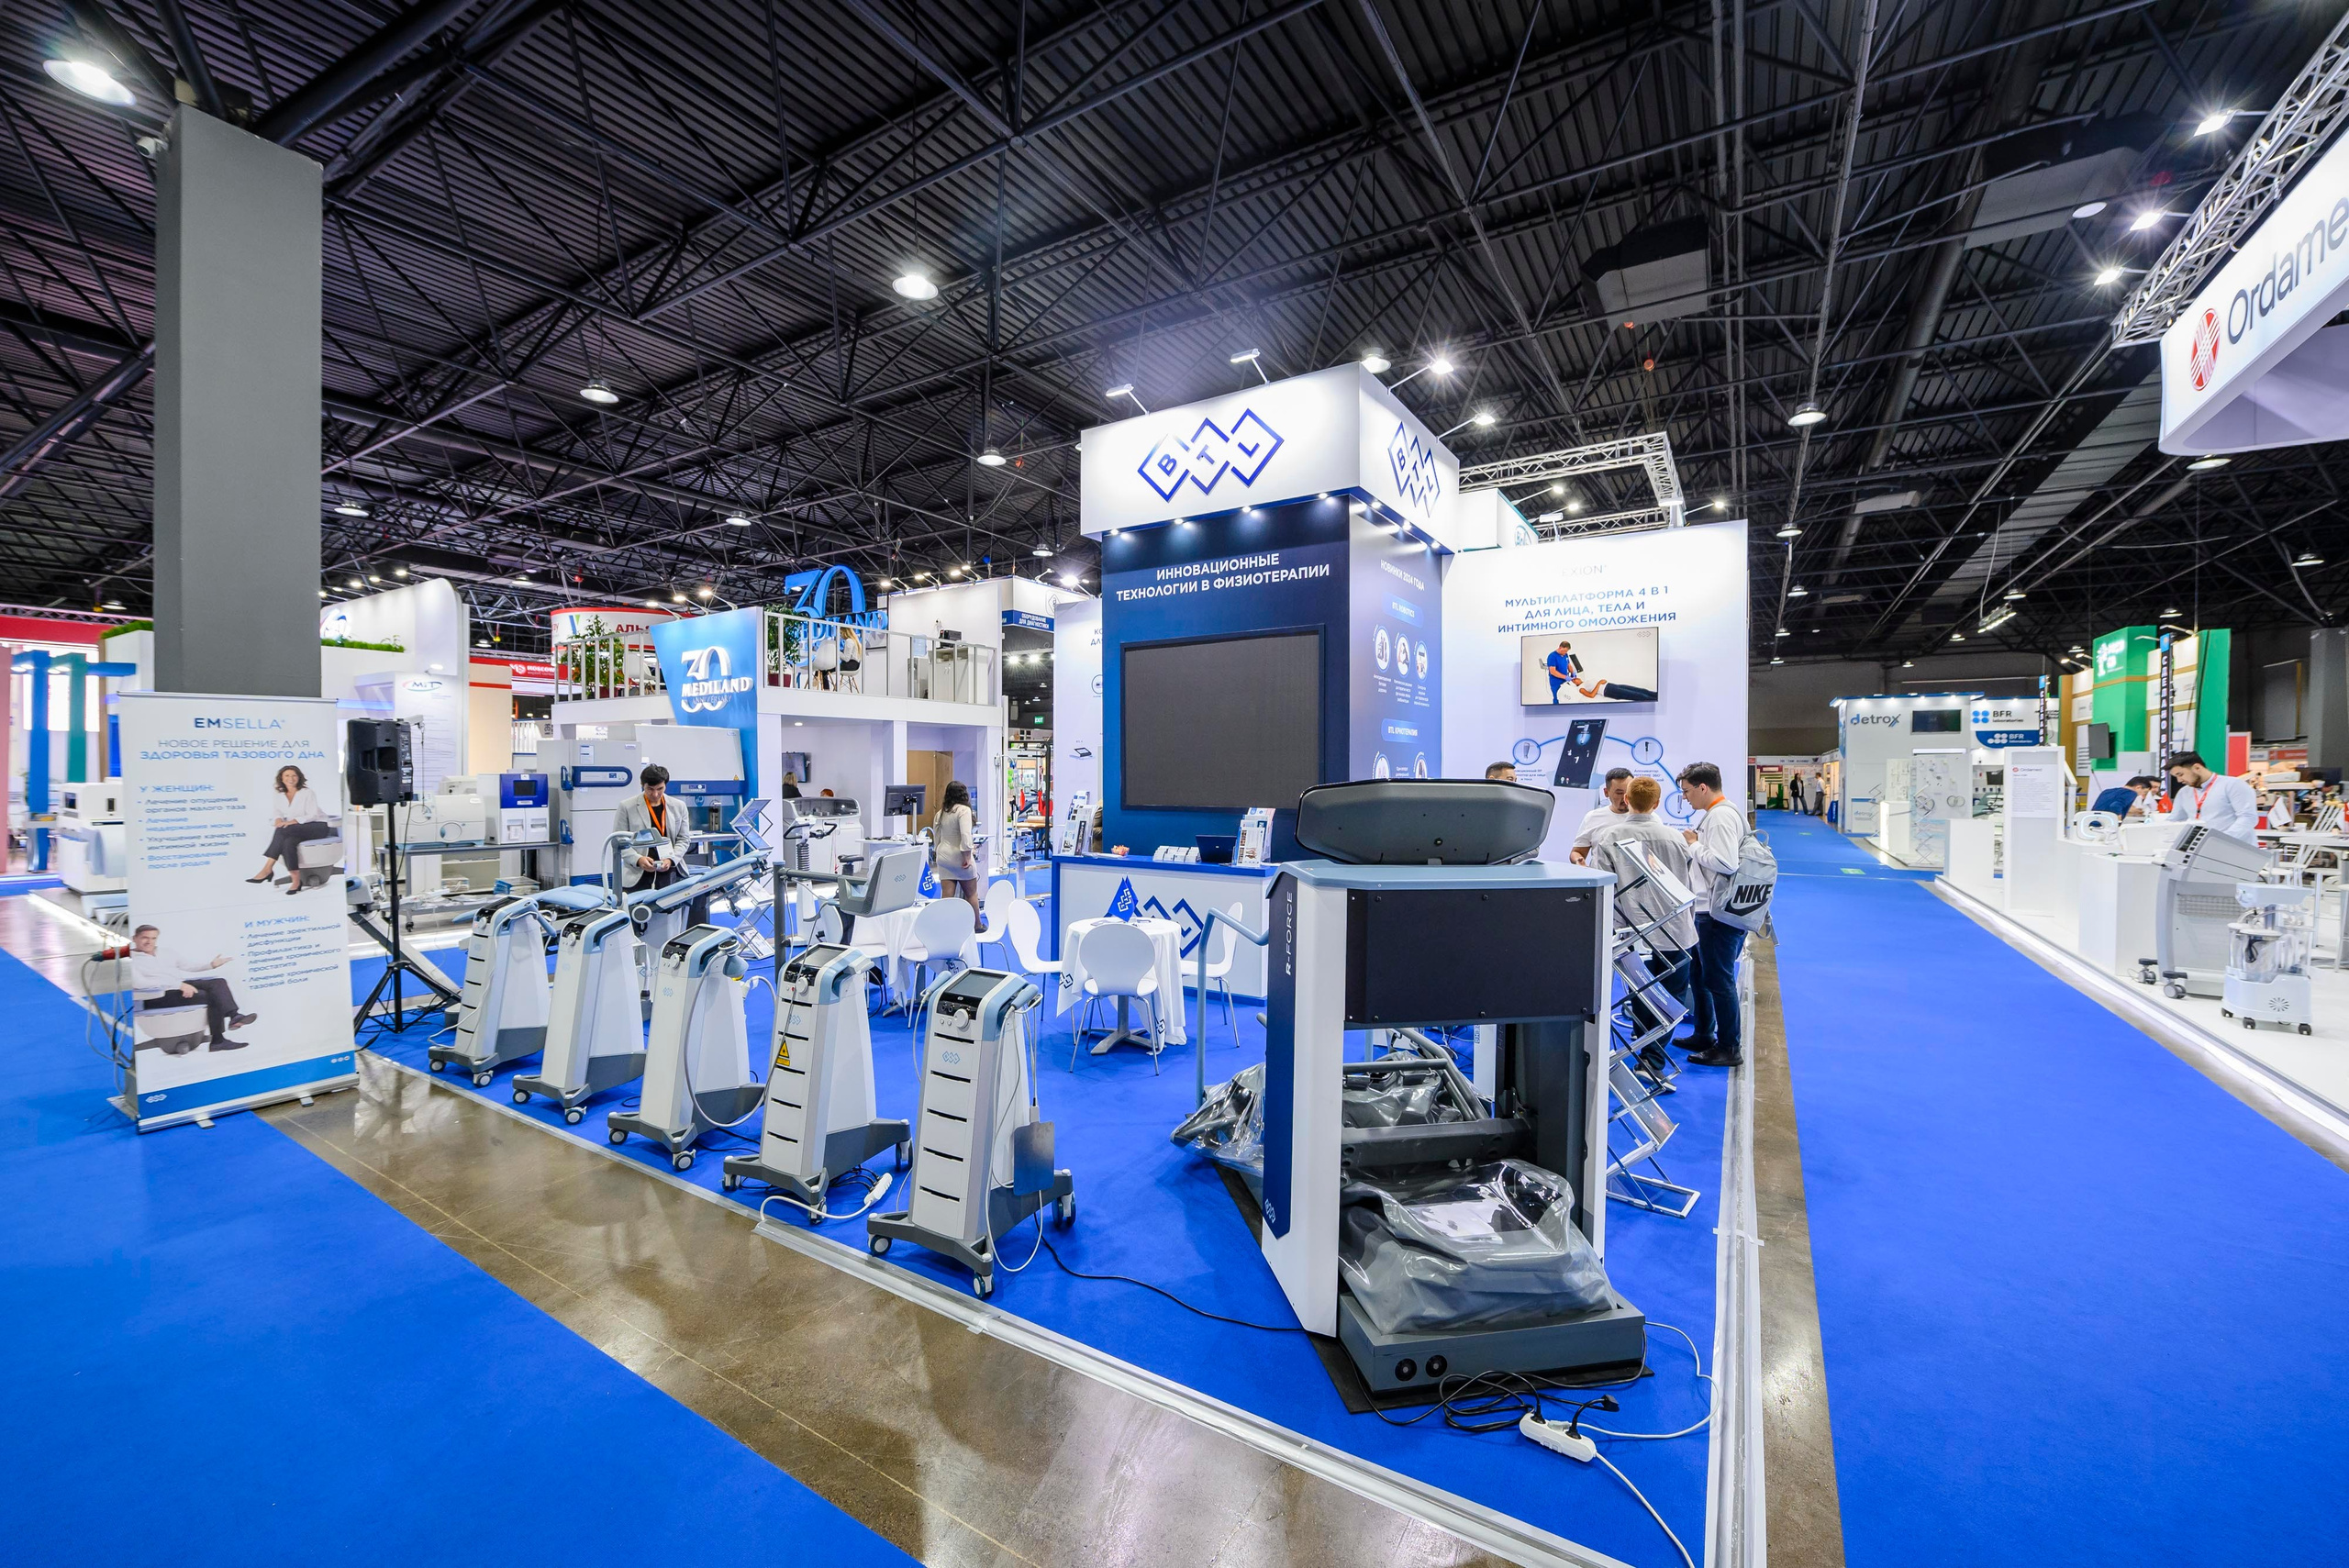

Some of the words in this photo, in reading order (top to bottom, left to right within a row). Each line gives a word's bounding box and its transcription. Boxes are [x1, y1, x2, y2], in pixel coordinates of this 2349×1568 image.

[1156, 553, 1279, 581] ИННОВАЦИОННЫЕ
[1562, 564, 1603, 577] EXION
[1381, 559, 1403, 579] НОВИНКИ
[1403, 572, 1413, 585] 2024
[1413, 577, 1425, 591] ГОДА
[1116, 581, 1197, 602] ТЕХНОЛОГИИ
[1201, 579, 1210, 591] В
[1213, 563, 1330, 590] ФИЗИОТЕРАПИИ
[1505, 588, 1633, 608] МУЛЬТИПЛАТФОРМА
[1638, 587, 1646, 596] 4
[1651, 586, 1659, 595] В
[1664, 585, 1669, 595] 1
[1391, 601, 1399, 612] BTL
[1399, 605, 1415, 618] ROBOTICS
[1524, 608, 1551, 620] ДЛЯ
[1554, 605, 1594, 617] ЛИЦА,
[1598, 602, 1631, 614] ТЕЛА
[1636, 601, 1645, 610] И
[1497, 619, 1575, 633] ИНТИМНОГО
[1578, 612, 1676, 628] ОМОЛОЖЕНИЯ
[681, 676, 754, 697] MEDILAND
[1850, 713, 1901, 728] detrox
[158, 740, 208, 748] НОВОЕ
[213, 740, 278, 749] РЕШЕНИЕ
[282, 740, 309, 749] ДЛЯ
[140, 751, 219, 760] ЗДОРОВЬЯ
[224, 751, 295, 759] ТАЗОВОГО
[298, 751, 325, 759] ДНА
[139, 785, 148, 794] У
[151, 784, 215, 794] ЖЕНЩИН:
[190, 796, 239, 806] опущения
[145, 806, 186, 814] органов
[189, 805, 223, 813] малого
[146, 834, 202, 843] Улучшение
[147, 841, 196, 851] интимной
[147, 851, 228, 862] Восстановление
[181, 860, 210, 868] родов
[1732, 884, 1773, 904] NIKE
[256, 916, 310, 927] МУЖЧИН:
[247, 930, 284, 940] Лечение
[286, 923, 341, 934] эректильной
[247, 937, 301, 948] дисфункции
[248, 944, 313, 957] Профилактика
[285, 948, 341, 960] хронического
[248, 973, 284, 982] Лечение
[286, 964, 339, 976] хронической
[249, 962, 297, 973] простатита
[249, 980, 284, 990] тазовой
